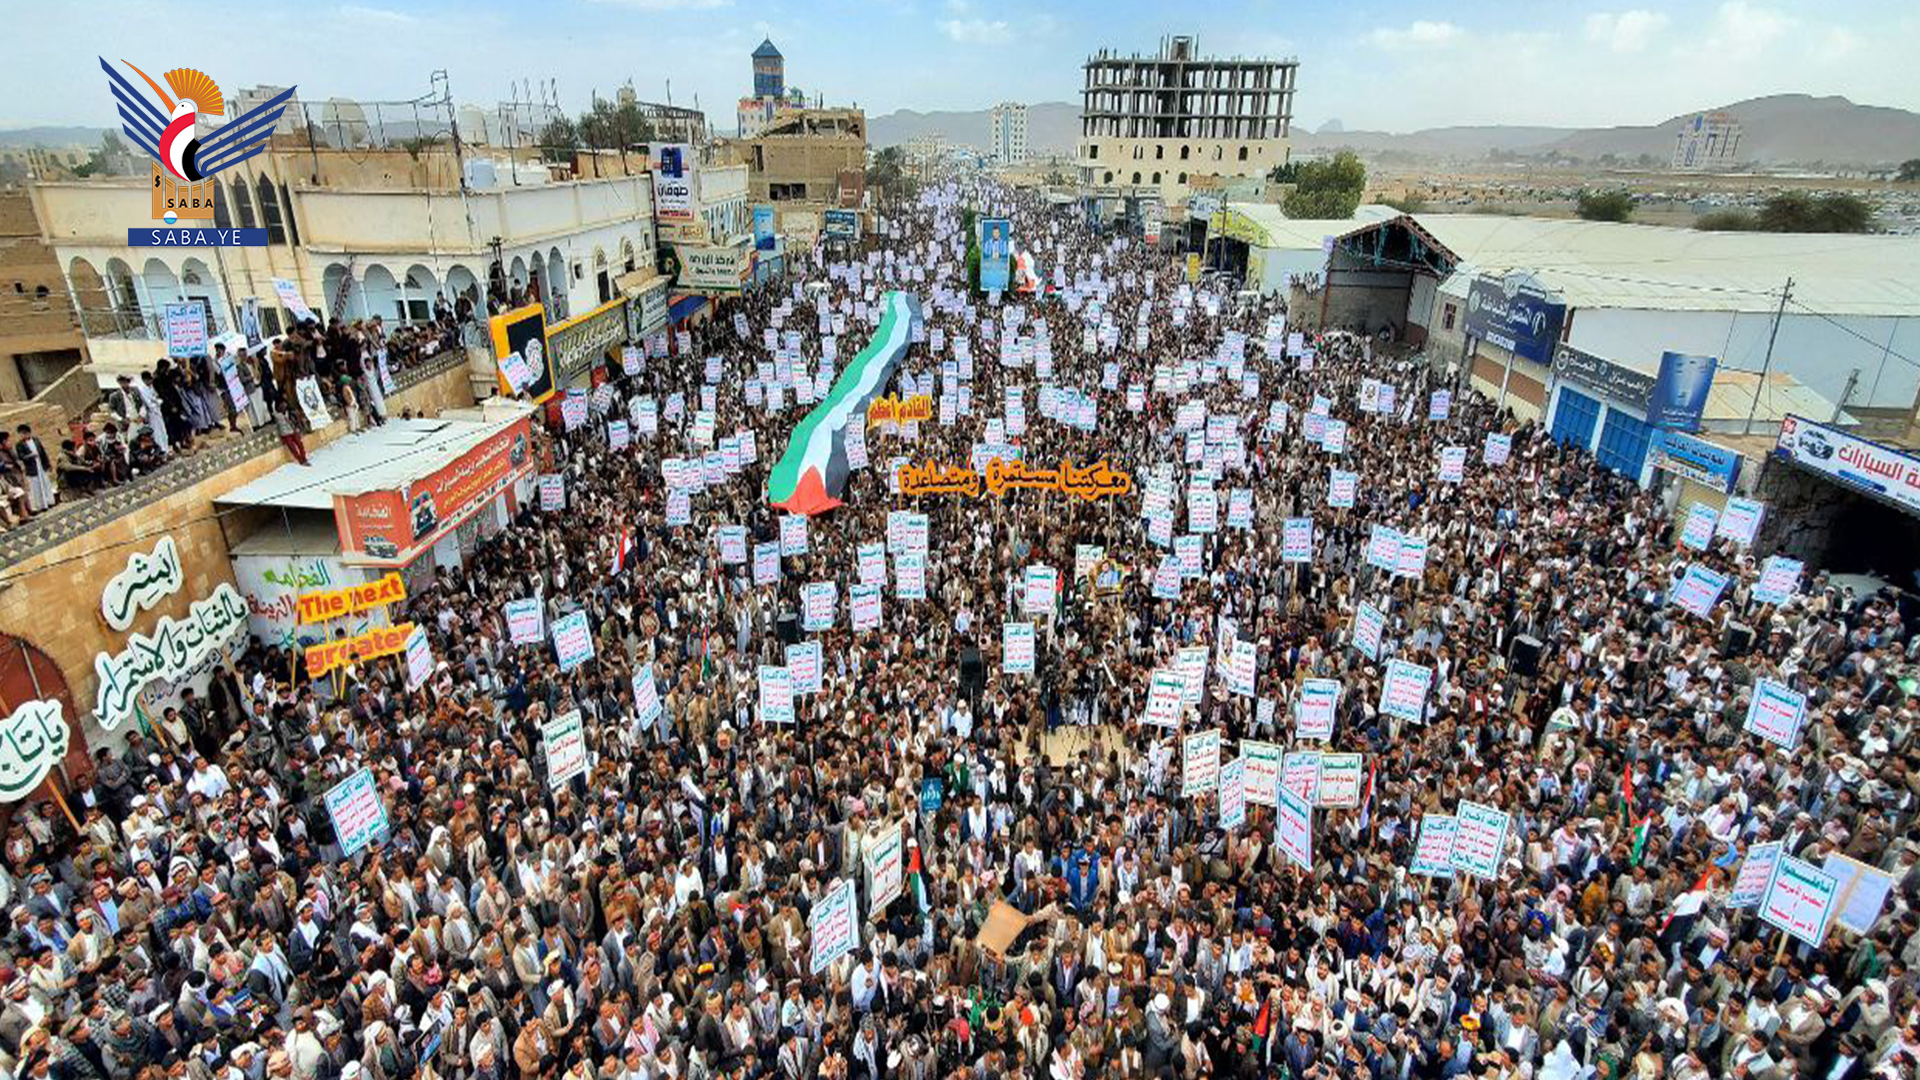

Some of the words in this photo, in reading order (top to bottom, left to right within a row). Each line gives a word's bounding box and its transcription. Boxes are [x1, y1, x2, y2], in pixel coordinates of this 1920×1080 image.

[992, 462, 1057, 489] مستمرة
[1838, 443, 1904, 480] السيارات
[902, 468, 978, 492] ومتصاعدة
[1064, 464, 1126, 496] معركتنا
[300, 595, 345, 618] The
[349, 578, 402, 606] next
[307, 628, 411, 667] greater
